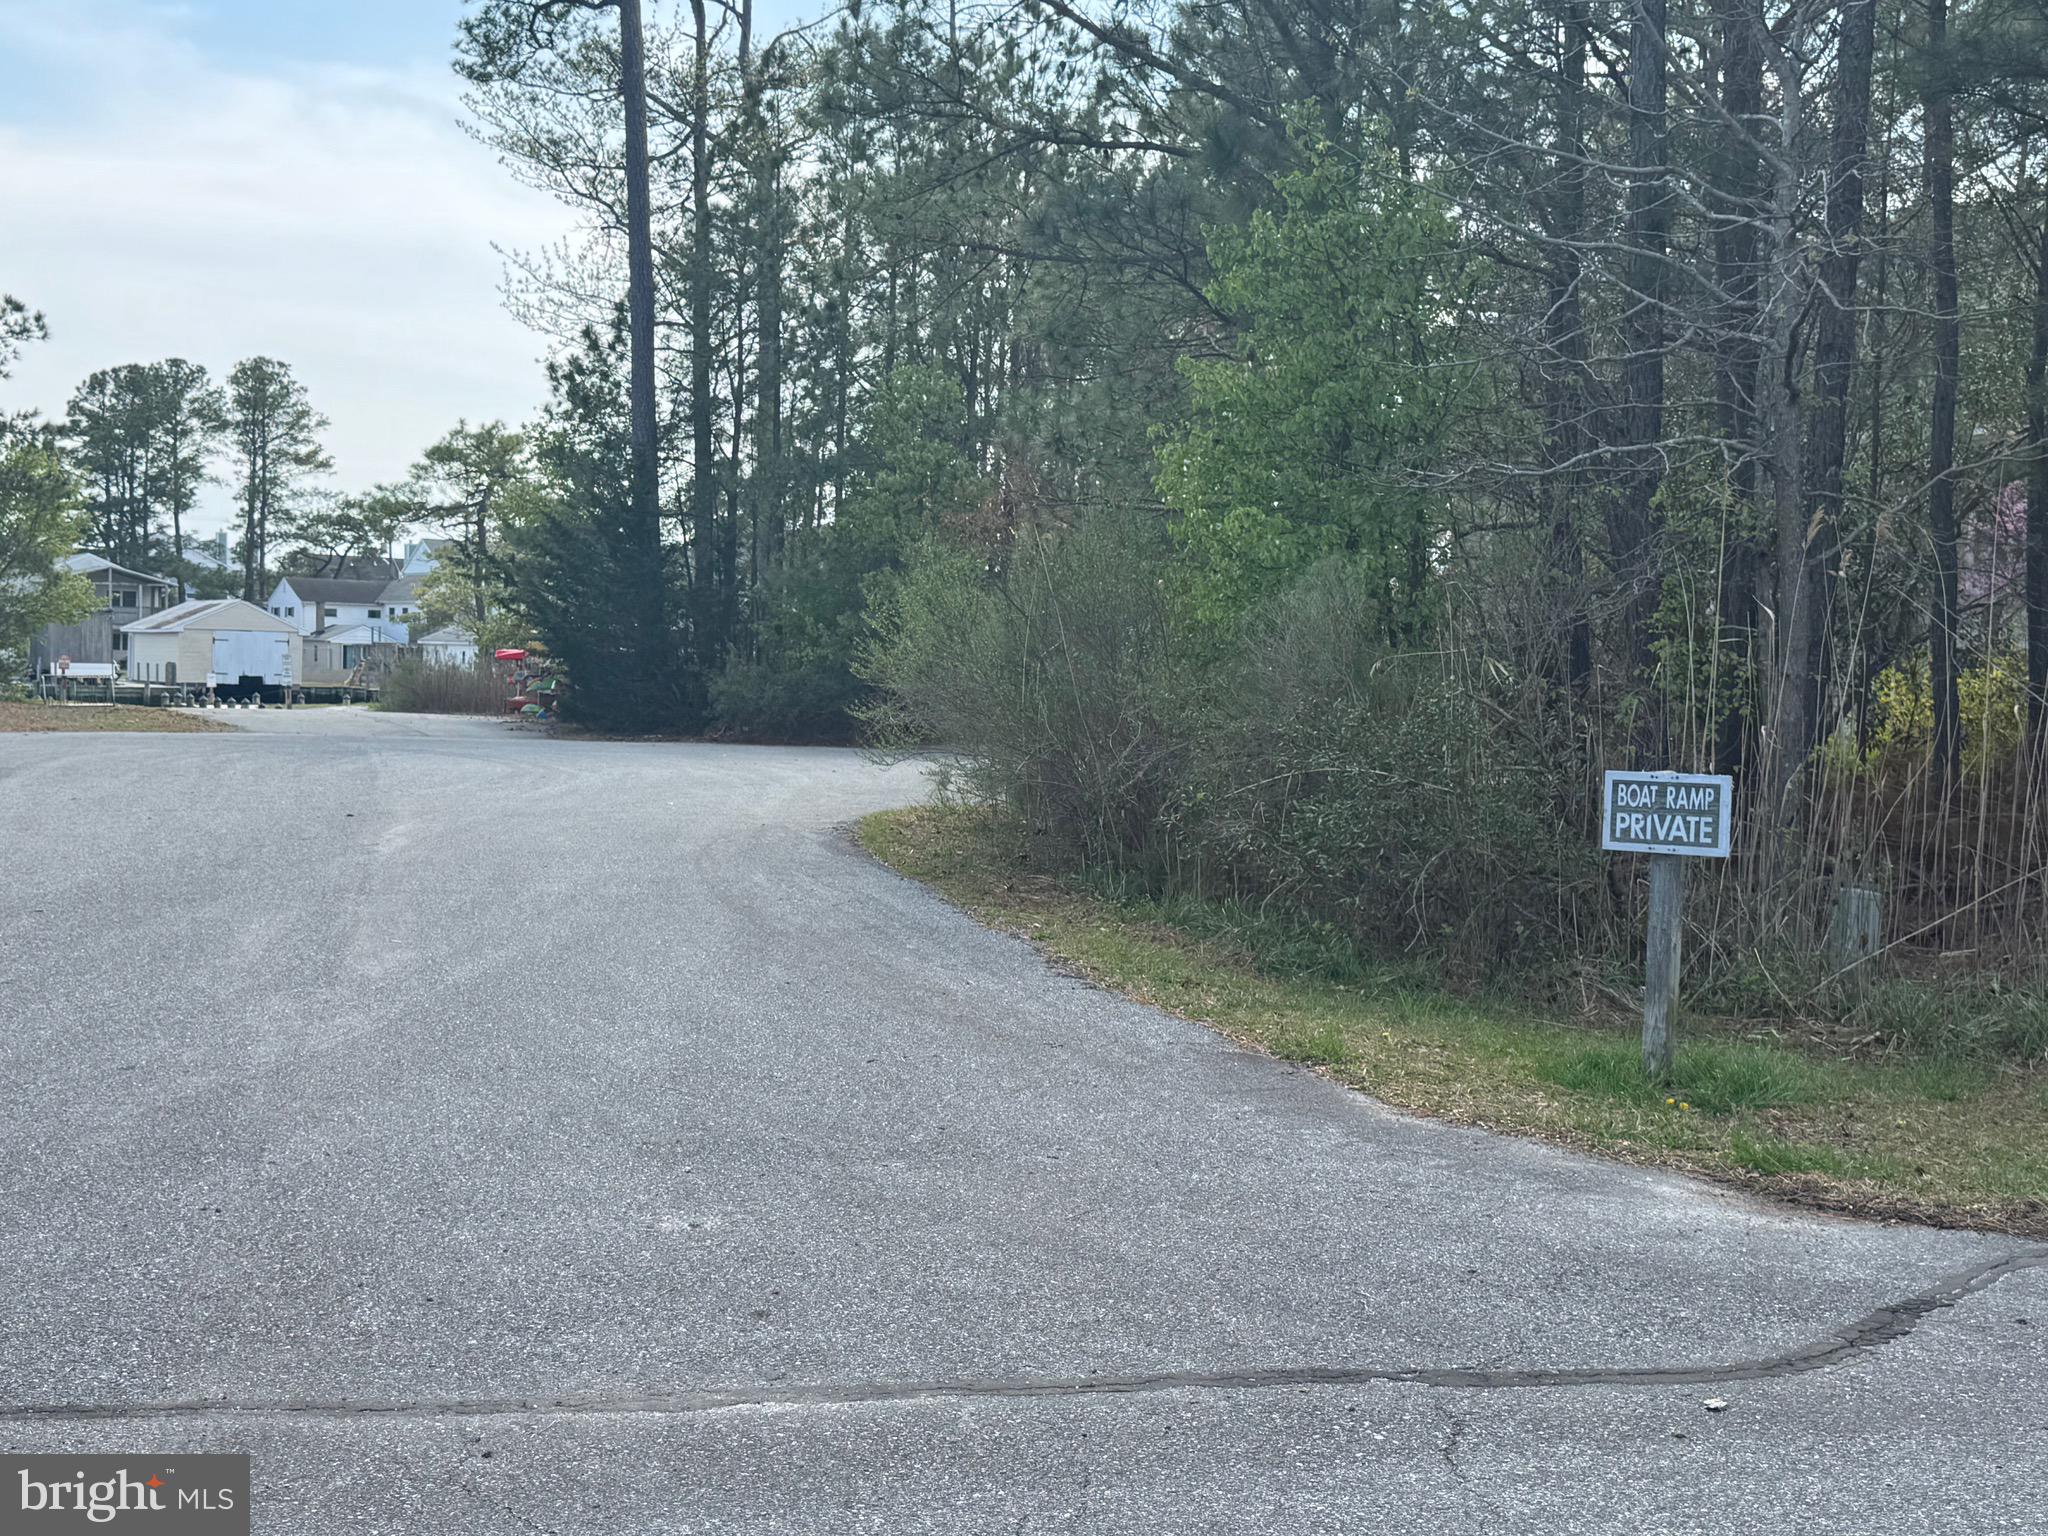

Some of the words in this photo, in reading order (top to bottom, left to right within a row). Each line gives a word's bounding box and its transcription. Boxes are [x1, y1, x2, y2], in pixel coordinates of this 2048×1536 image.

[1617, 783, 1658, 808] BOAT
[1666, 786, 1714, 810] RAMP
[1615, 812, 1713, 844] PRIVATE
